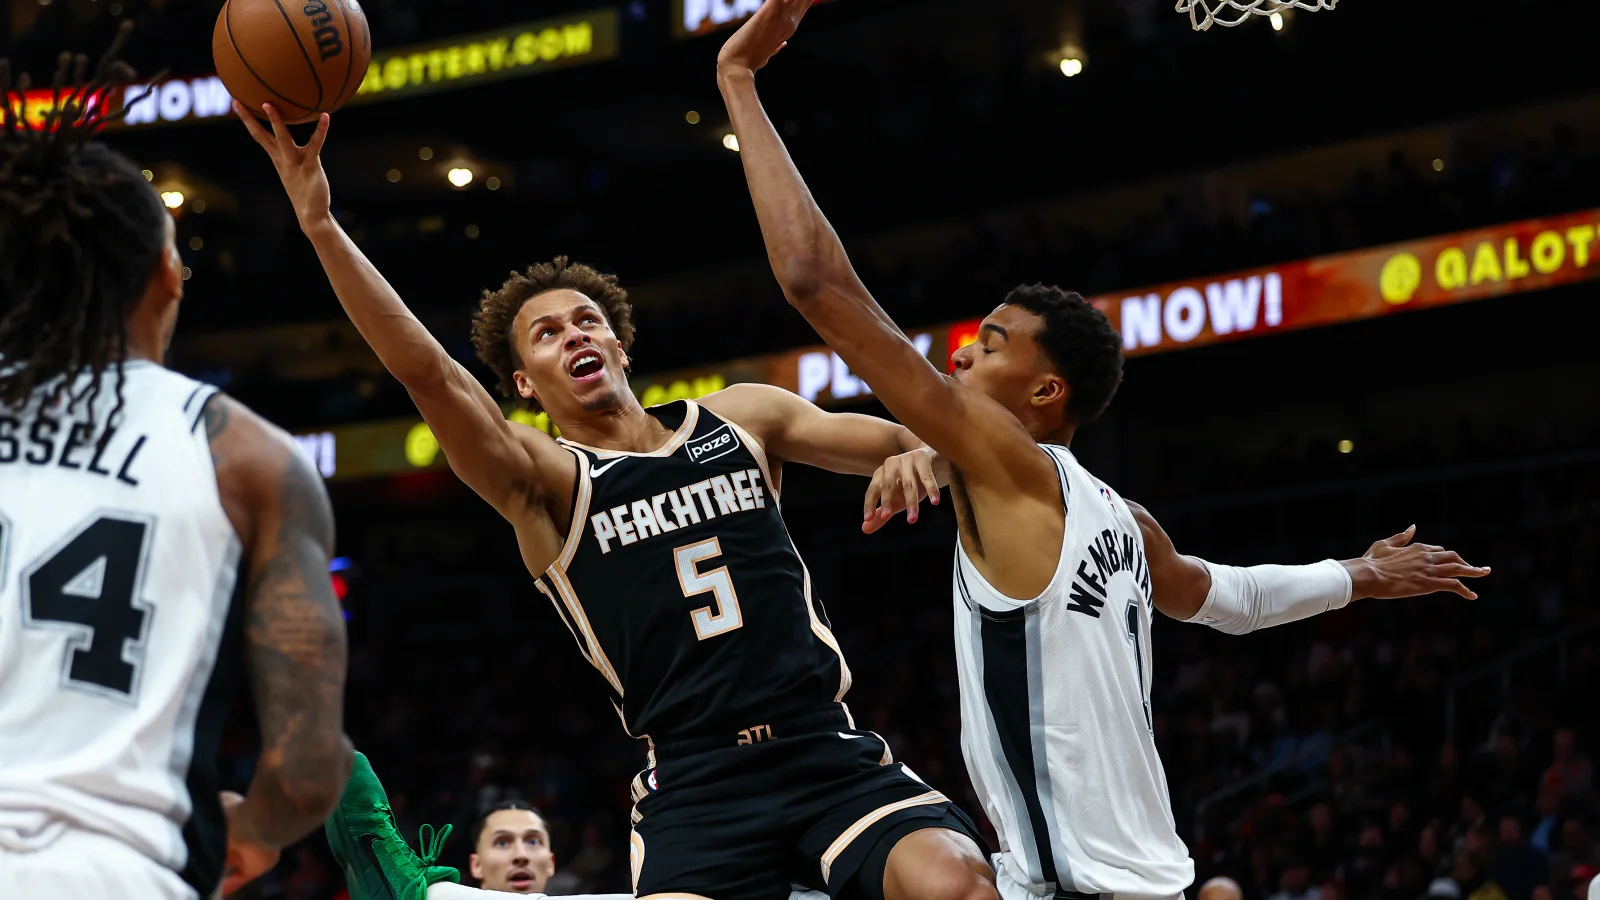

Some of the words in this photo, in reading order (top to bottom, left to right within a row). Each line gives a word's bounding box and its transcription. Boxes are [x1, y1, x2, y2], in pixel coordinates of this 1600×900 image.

[357, 21, 592, 95] LOTTERY.COM
[1435, 222, 1600, 290] GALOT
[1120, 272, 1284, 351] NOW!
[691, 432, 731, 459] paze
[590, 468, 766, 555] PEACHTREE
[0, 507, 158, 710] 4
[673, 535, 744, 641] 5
